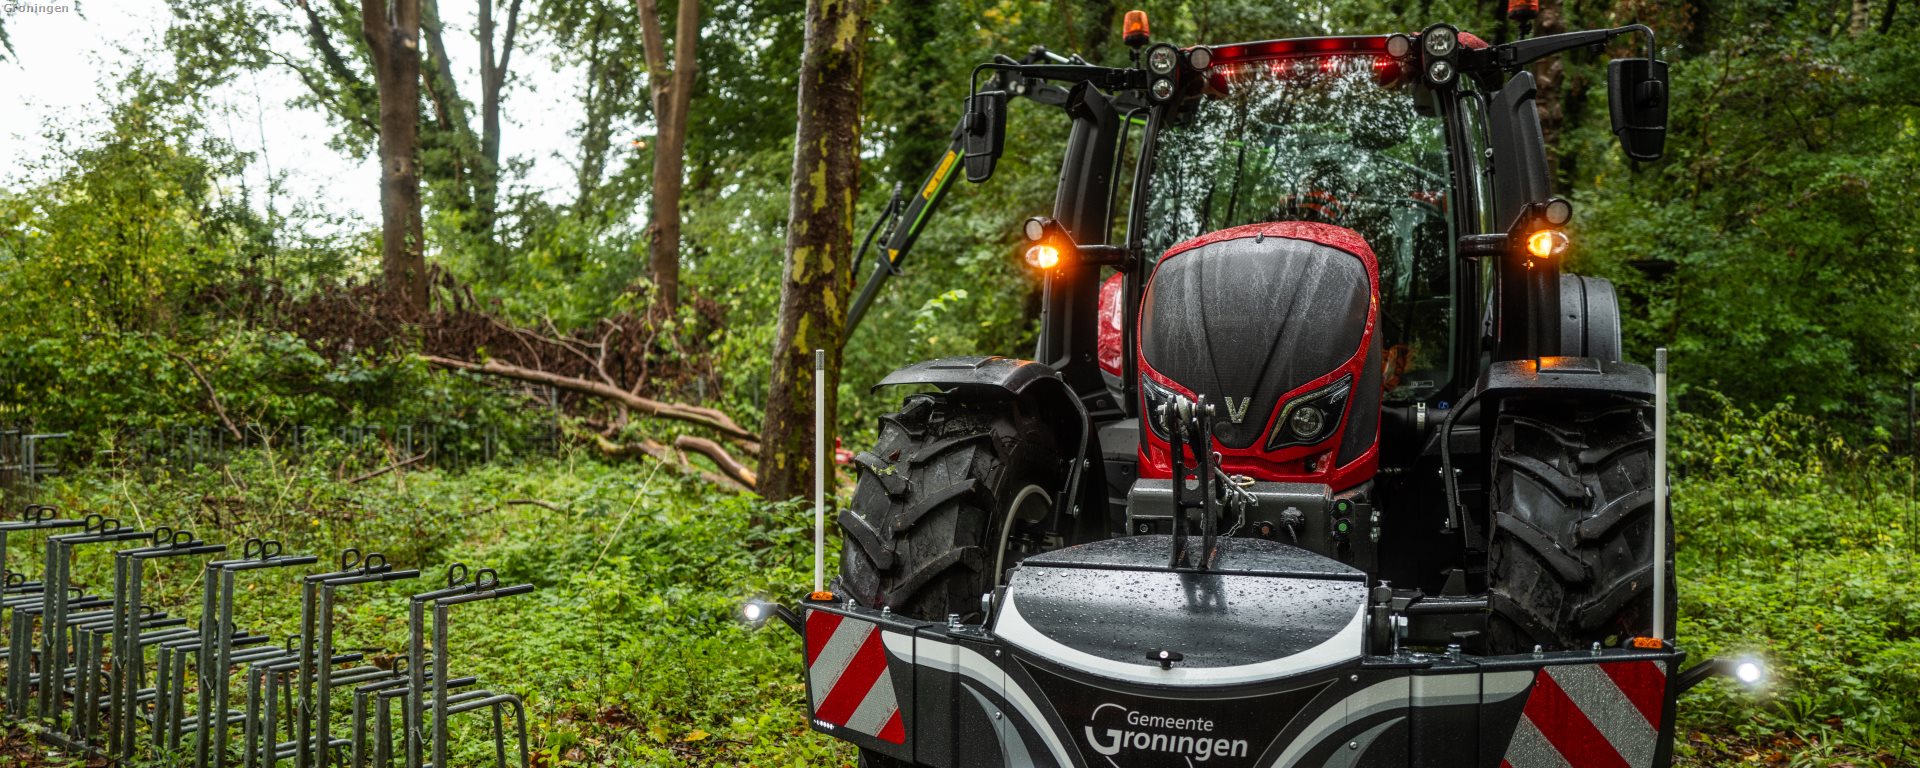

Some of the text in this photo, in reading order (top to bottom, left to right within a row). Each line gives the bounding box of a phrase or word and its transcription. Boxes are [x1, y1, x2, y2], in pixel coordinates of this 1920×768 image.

[1224, 396, 1252, 424] V
[1085, 703, 1248, 762] Groningen
[1127, 711, 1214, 732] Gemeente
